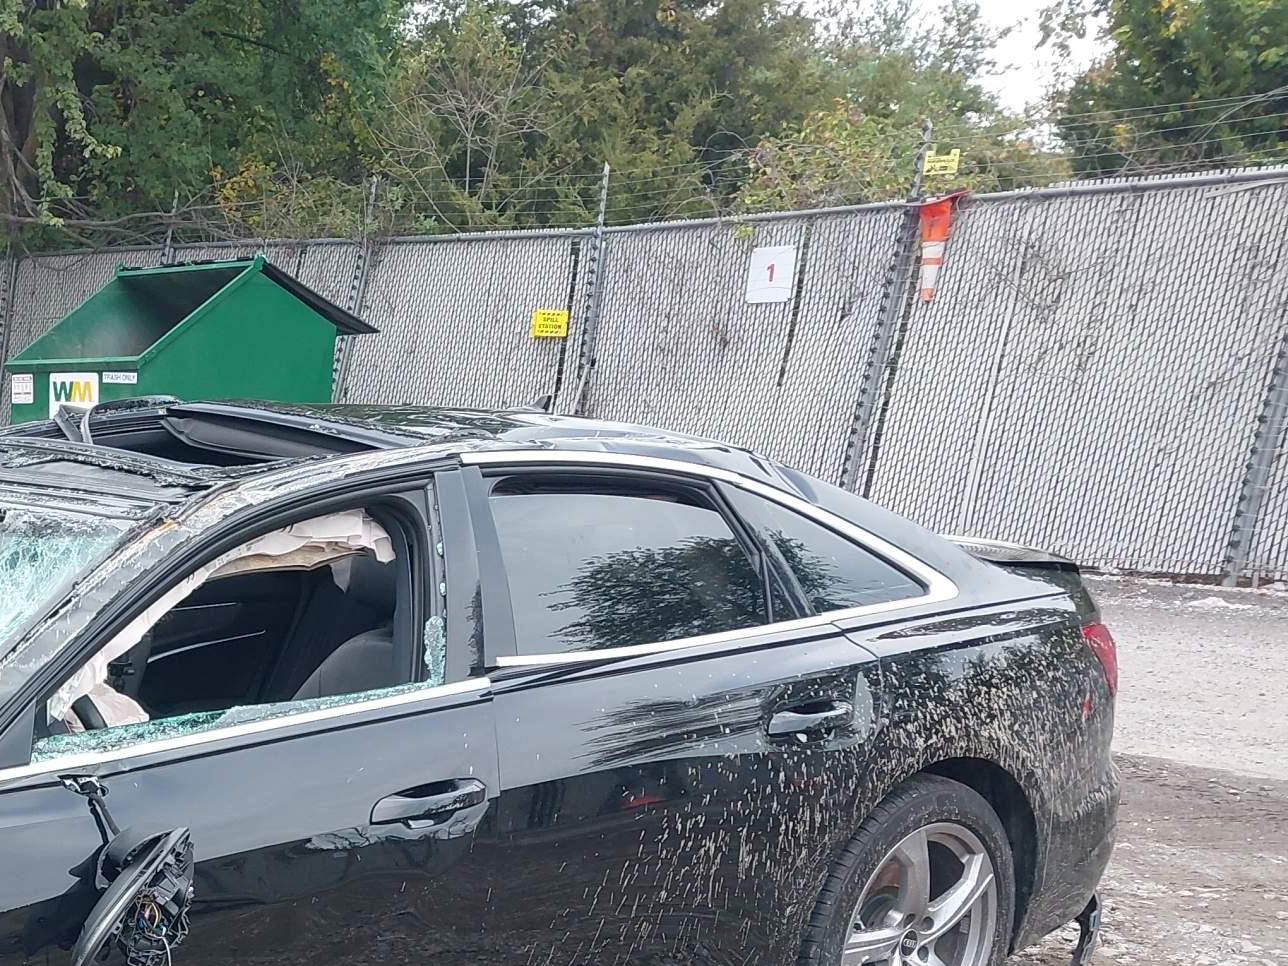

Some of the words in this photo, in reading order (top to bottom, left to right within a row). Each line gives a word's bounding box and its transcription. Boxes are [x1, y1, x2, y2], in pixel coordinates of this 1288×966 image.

[767, 264, 775, 282] 1
[122, 373, 136, 381] ONLY
[53, 381, 93, 402] WM
